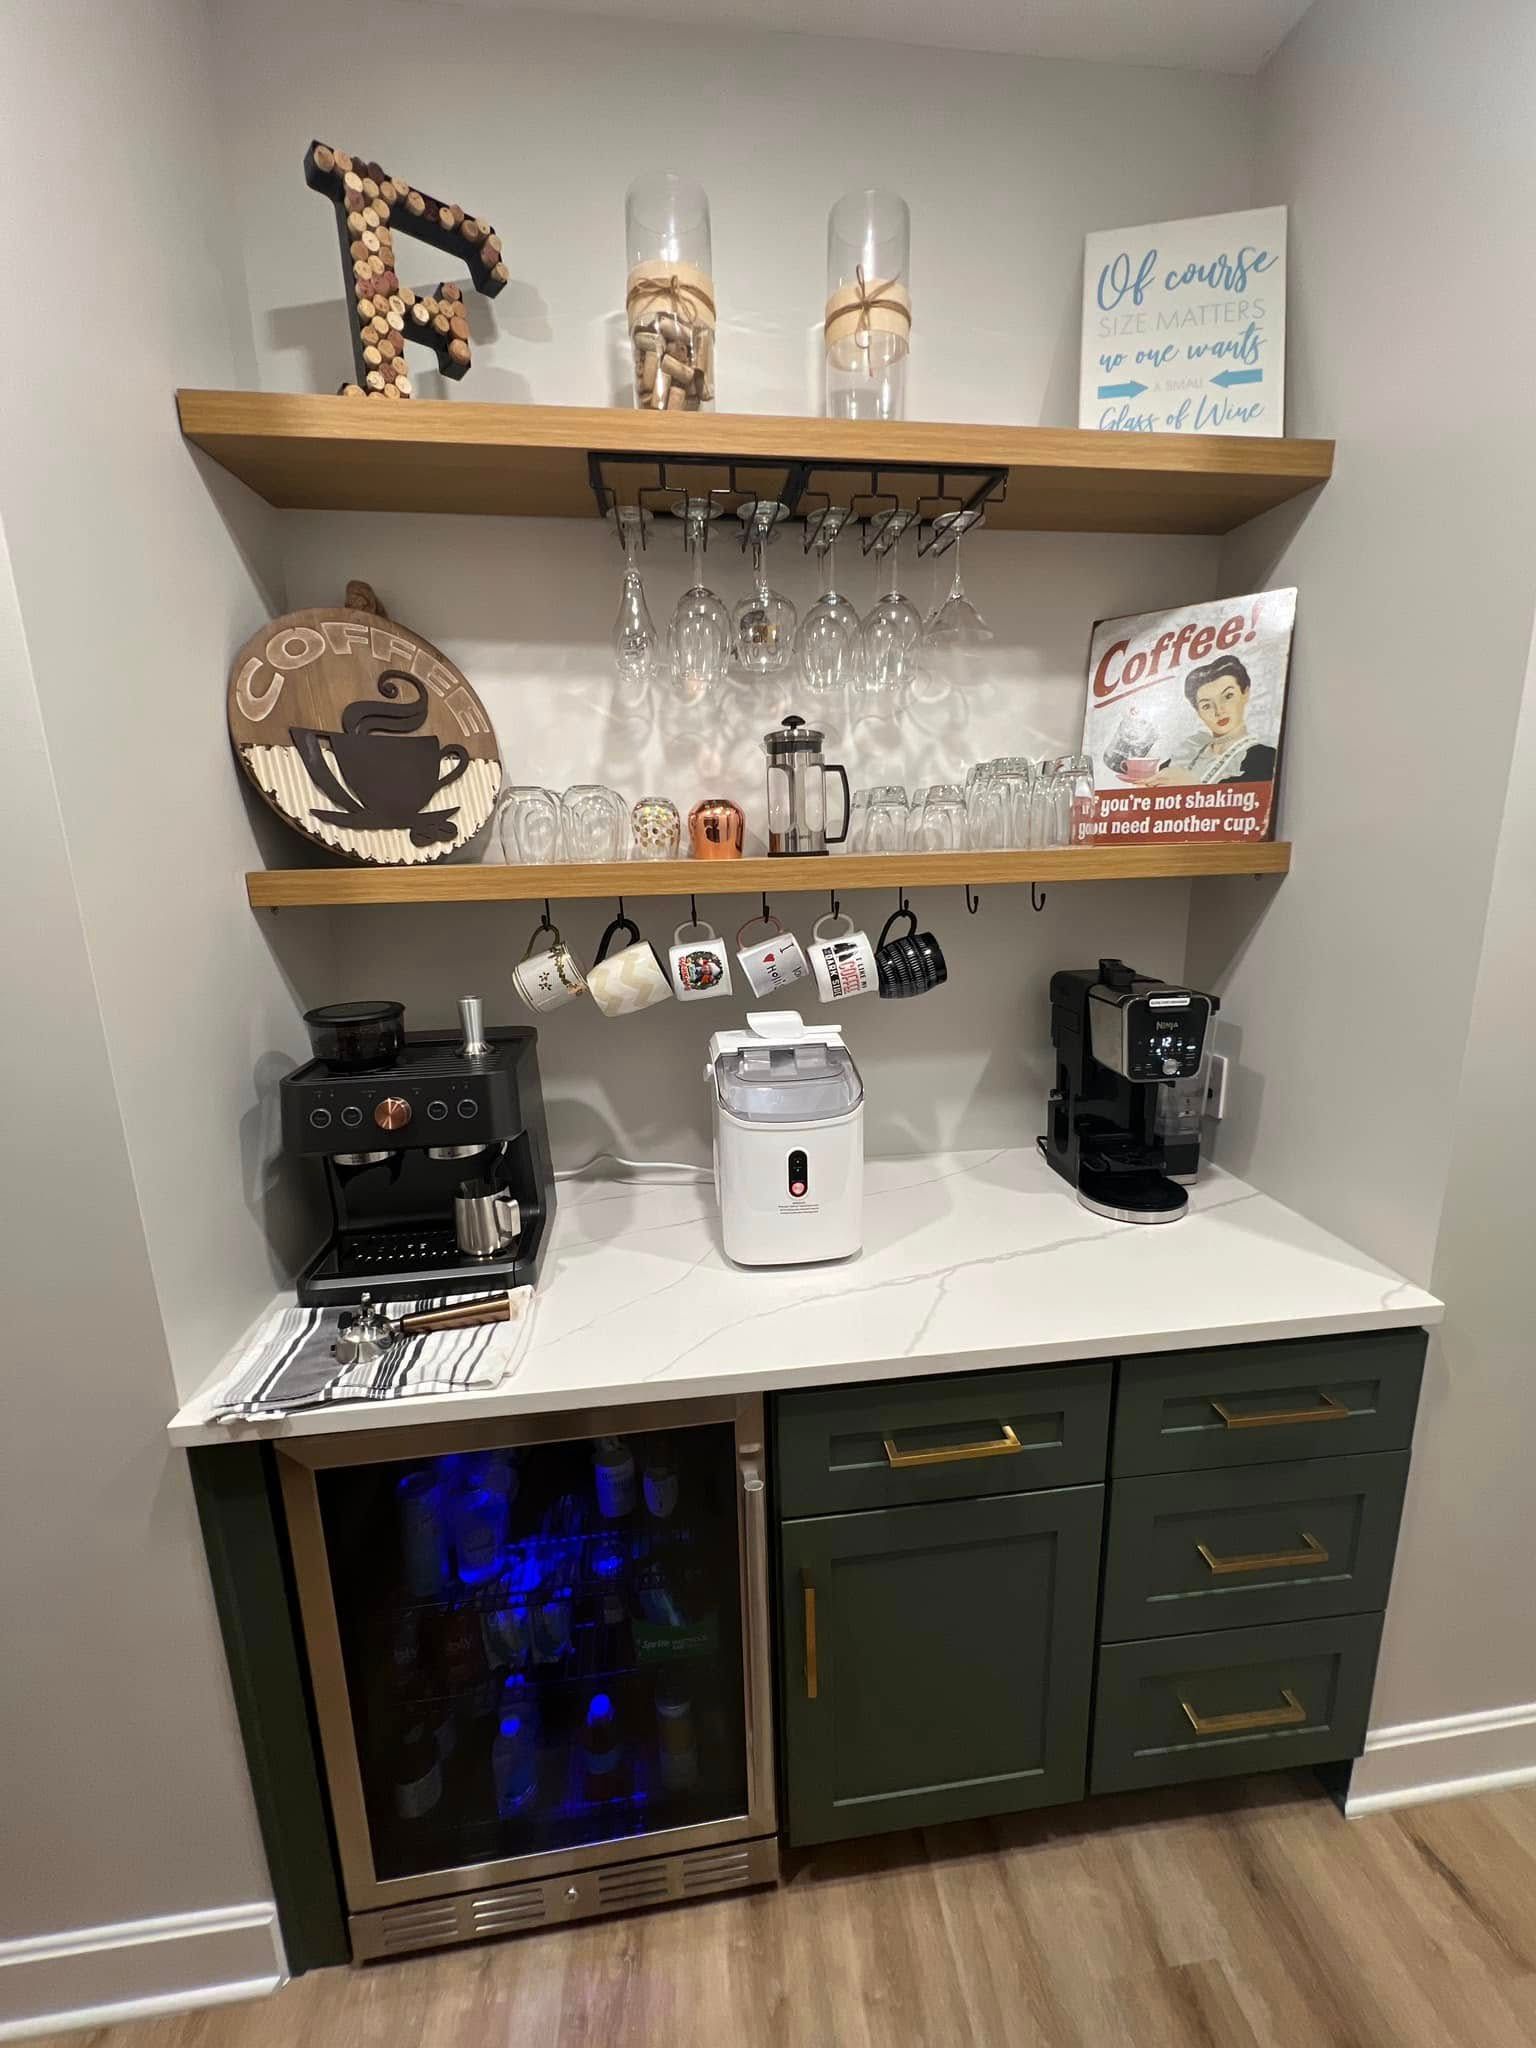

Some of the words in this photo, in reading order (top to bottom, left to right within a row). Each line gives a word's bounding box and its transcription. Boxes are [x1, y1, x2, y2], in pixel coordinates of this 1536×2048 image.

[1097, 249, 1157, 311] Of
[1164, 246, 1279, 293] course
[1098, 312, 1147, 338] SIZE
[1156, 299, 1266, 332] MATTERS
[1099, 352, 1127, 373] no
[1135, 343, 1180, 367] one
[1187, 321, 1267, 365] wants
[1099, 404, 1159, 432] Glass
[1166, 397, 1192, 430] of
[1194, 395, 1265, 430] Wine
[1093, 598, 1265, 698] Coffee!
[236, 621, 490, 737] COFFEE
[1100, 794, 1151, 817] you're
[1153, 795, 1181, 811] not
[1184, 788, 1260, 811] shaking,
[1078, 822, 1108, 840] you
[1111, 816, 1151, 834] need
[1153, 813, 1220, 833] another
[1223, 816, 1261, 836] cup.
[825, 954, 838, 977] DARK
[832, 979, 842, 997] SIDE
